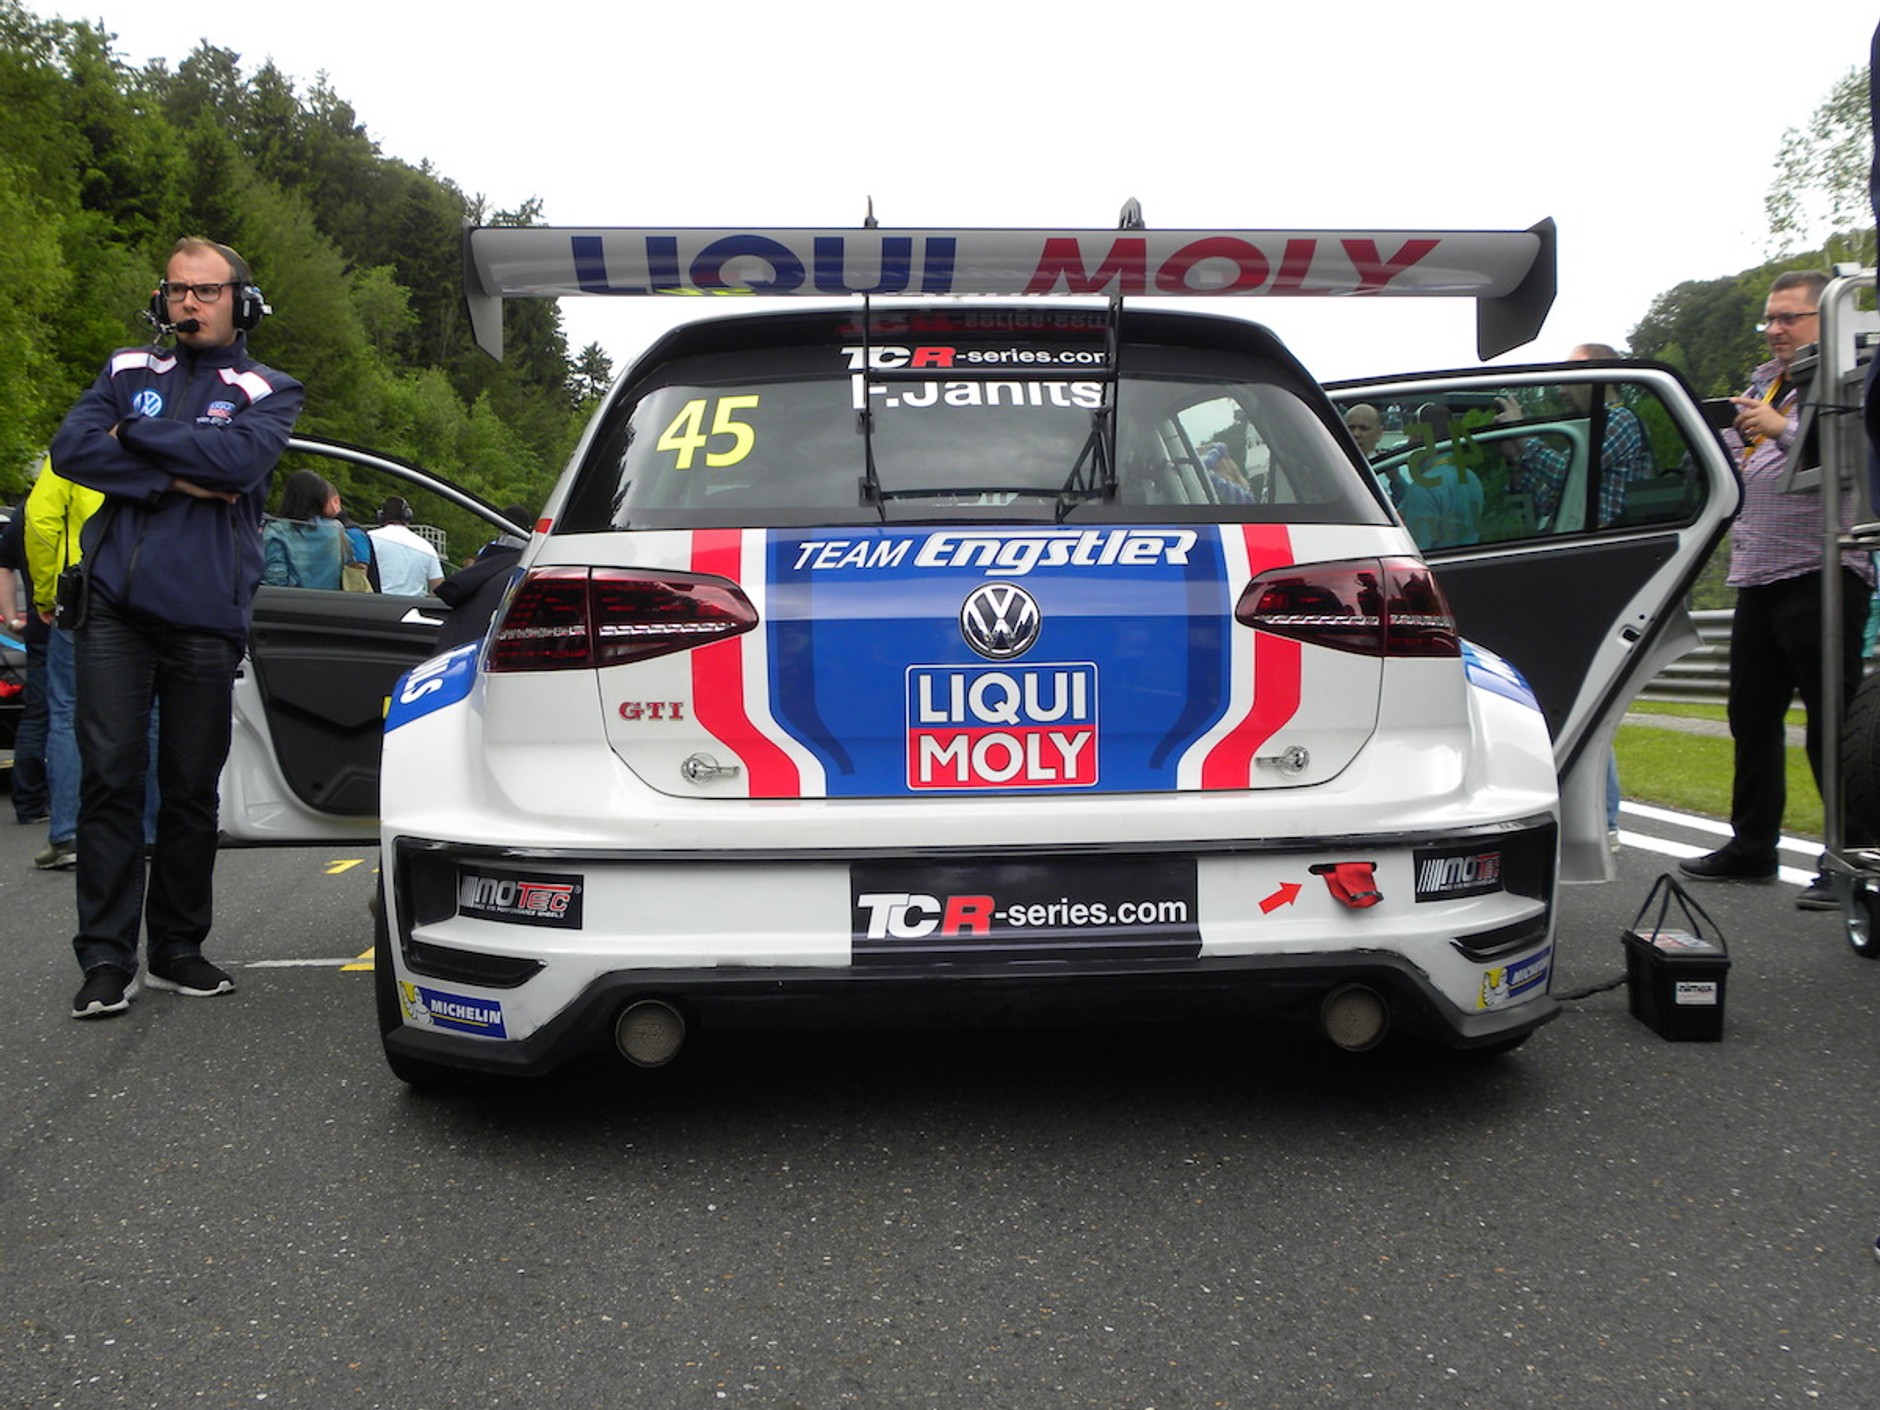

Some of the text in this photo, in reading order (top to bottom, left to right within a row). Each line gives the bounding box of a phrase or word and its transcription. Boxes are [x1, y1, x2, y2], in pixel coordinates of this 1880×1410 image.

[571, 234, 1442, 297] LIQUI MOLY
[656, 395, 759, 470] 45
[793, 540, 913, 570] TEAM
[619, 701, 684, 720] GTI
[919, 672, 1087, 725] LIQUI
[919, 732, 1092, 783] MOLY
[857, 892, 1188, 939] TCR-series.com
[430, 999, 501, 1024] MICHELIN
